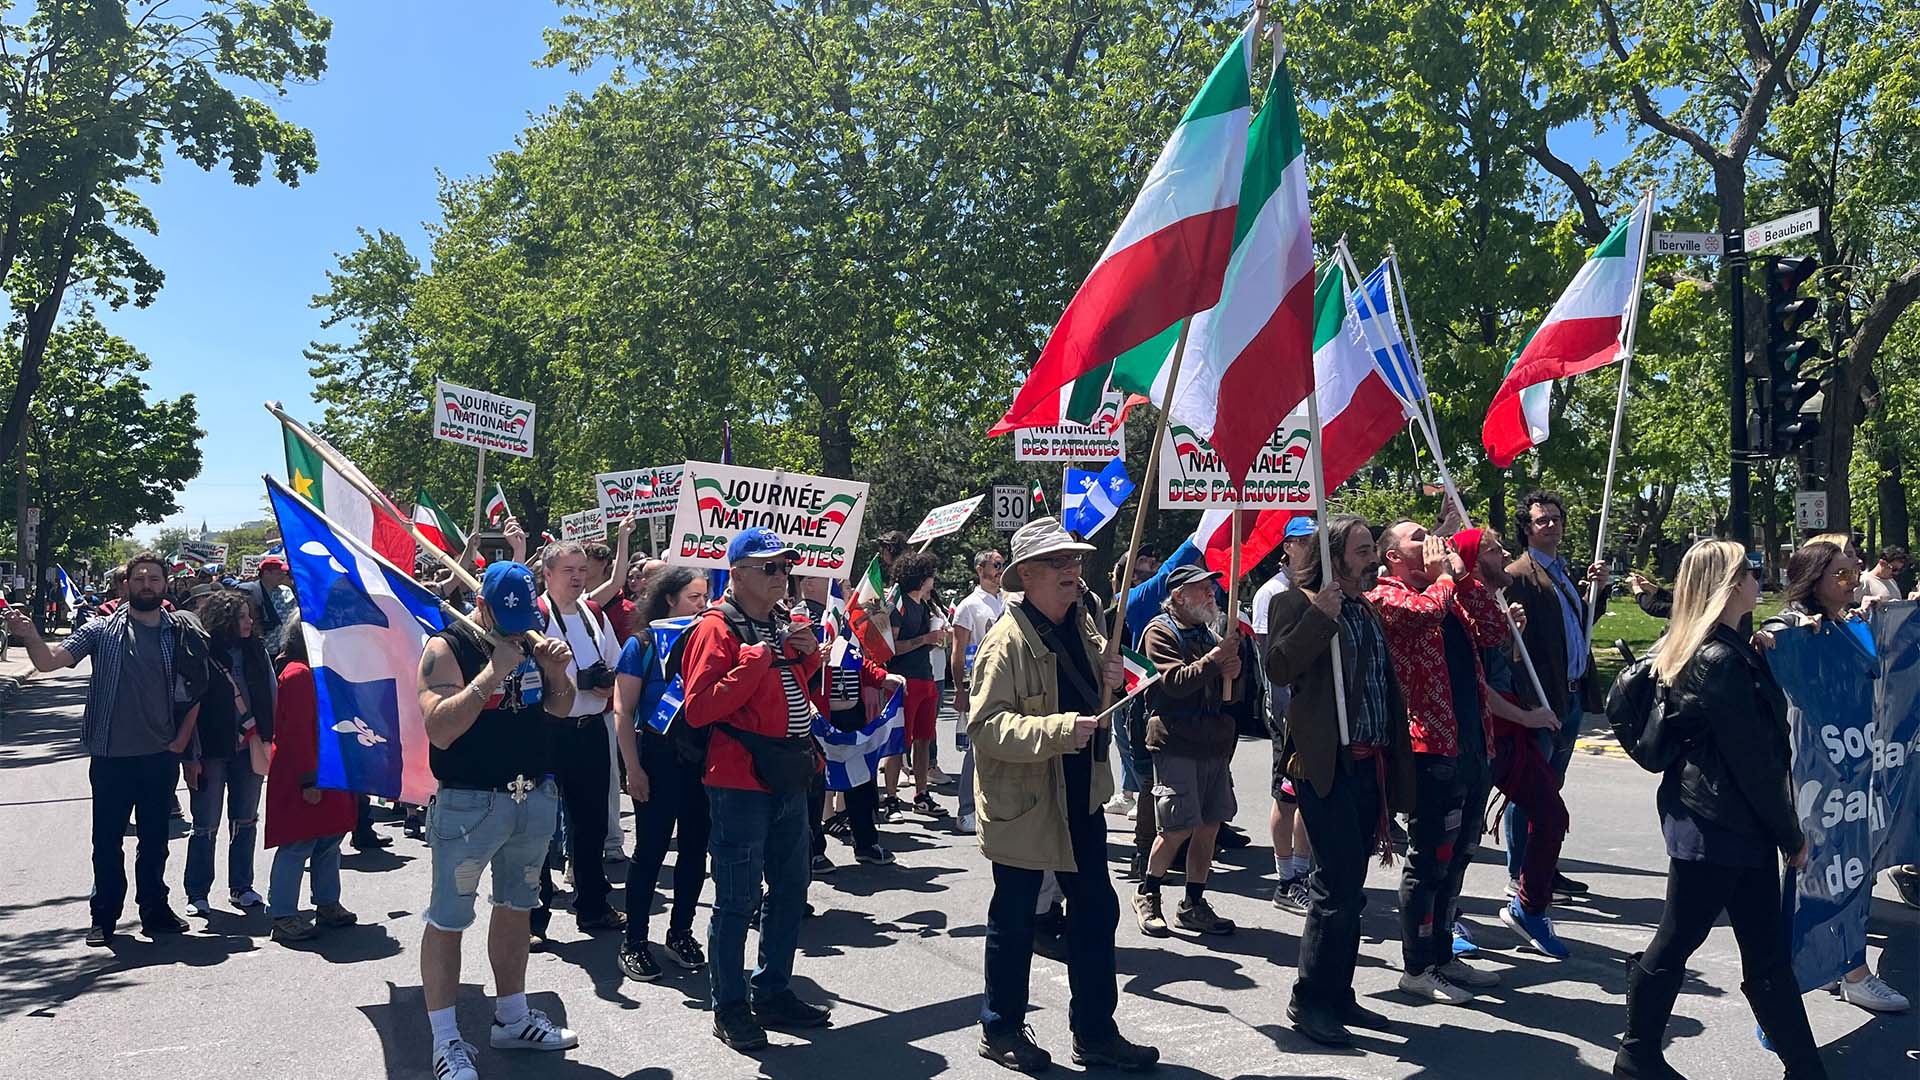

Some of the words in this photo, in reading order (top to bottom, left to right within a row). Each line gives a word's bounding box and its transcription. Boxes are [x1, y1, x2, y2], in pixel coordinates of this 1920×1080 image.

[1765, 219, 1812, 241] Beaubien
[1659, 239, 1701, 251] Iberville
[459, 394, 513, 417] JOURNÉE
[453, 408, 517, 434] NATIONALE
[440, 421, 465, 440] DES
[466, 427, 528, 453] PATRIOTES
[1022, 438, 1049, 456] DES
[1051, 438, 1120, 456] PATRIOTES
[724, 479, 826, 510] JOURNÉE
[1168, 478, 1208, 502] DES
[997, 495, 1024, 519] 30
[709, 506, 830, 539] NATIONALE
[680, 533, 728, 560] DES
